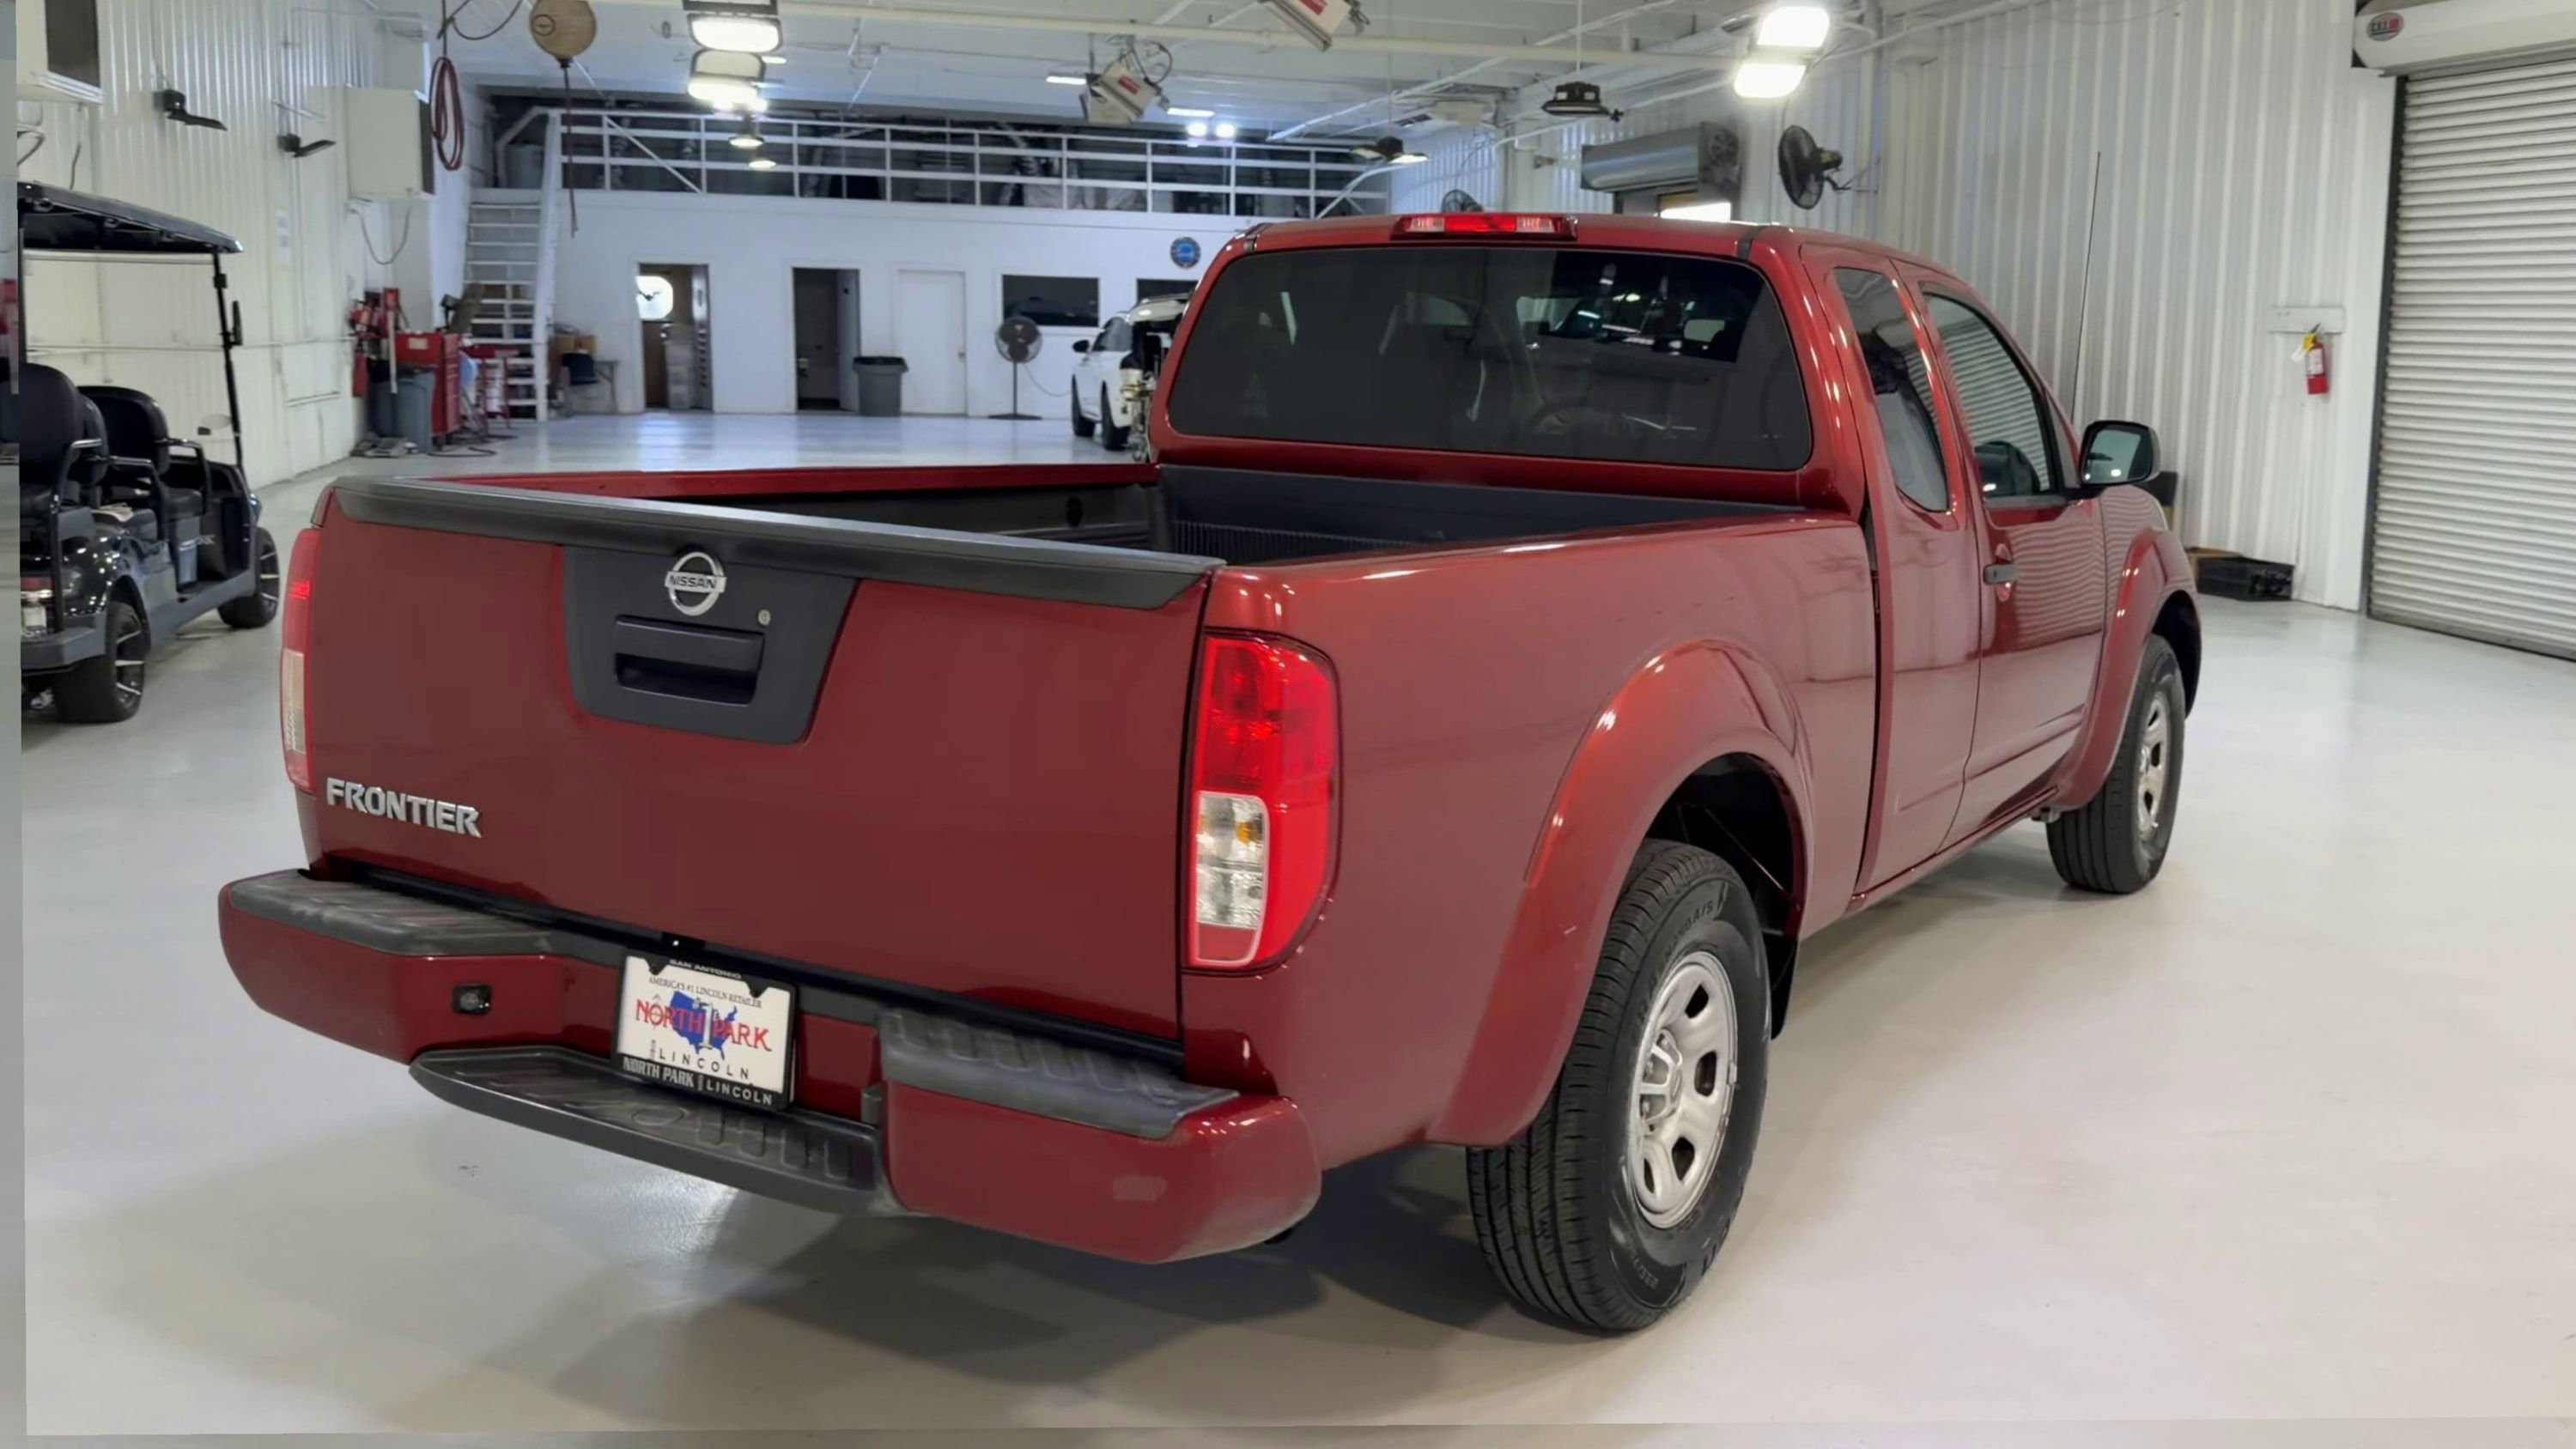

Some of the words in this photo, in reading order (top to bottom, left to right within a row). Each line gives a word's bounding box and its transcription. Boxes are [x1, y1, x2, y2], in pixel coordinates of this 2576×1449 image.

[671, 575, 716, 589] NISSAN
[326, 777, 482, 839] FRONTIER
[696, 985, 728, 1001] LINCOLN
[728, 993, 762, 1009] RETAILER
[635, 998, 706, 1034] NORTH
[713, 1016, 773, 1052] PARK
[623, 1056, 660, 1079] NORTH
[662, 1066, 695, 1088] PARK
[706, 1080, 772, 1106] LINCOLN
[659, 1047, 749, 1080] LINCOLN
